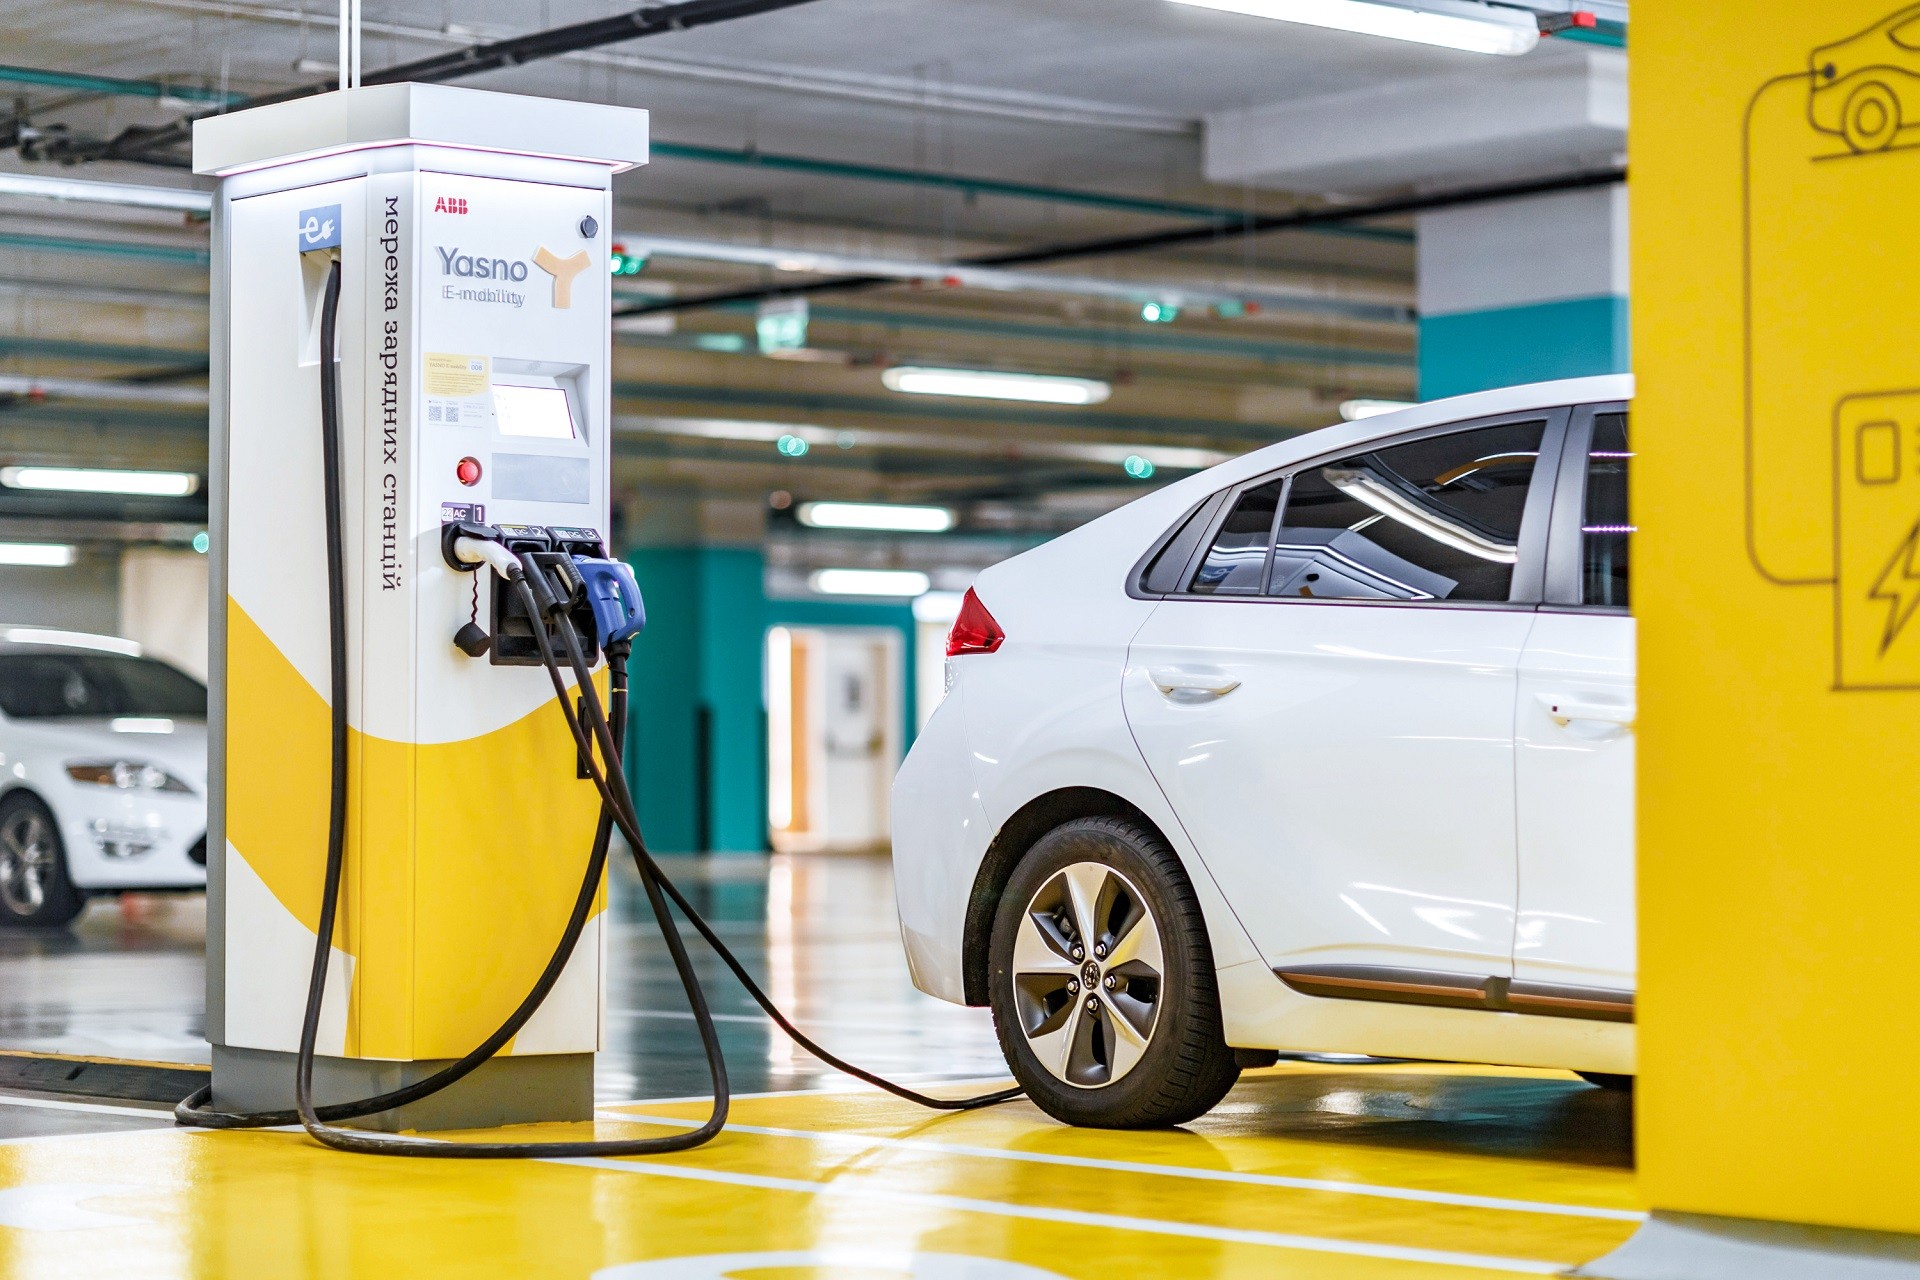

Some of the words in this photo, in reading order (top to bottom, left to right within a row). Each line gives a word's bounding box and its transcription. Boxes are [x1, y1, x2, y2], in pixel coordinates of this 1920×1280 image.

[434, 196, 468, 215] ABB
[380, 195, 399, 312] мережа
[437, 246, 528, 282] Yasno
[443, 285, 525, 308] E-mobility
[380, 320, 398, 464] зарядних
[454, 509, 466, 518] AC
[476, 506, 483, 522] 1
[380, 473, 402, 591] станцій
[532, 527, 543, 536] 2
[585, 530, 596, 539] 3
